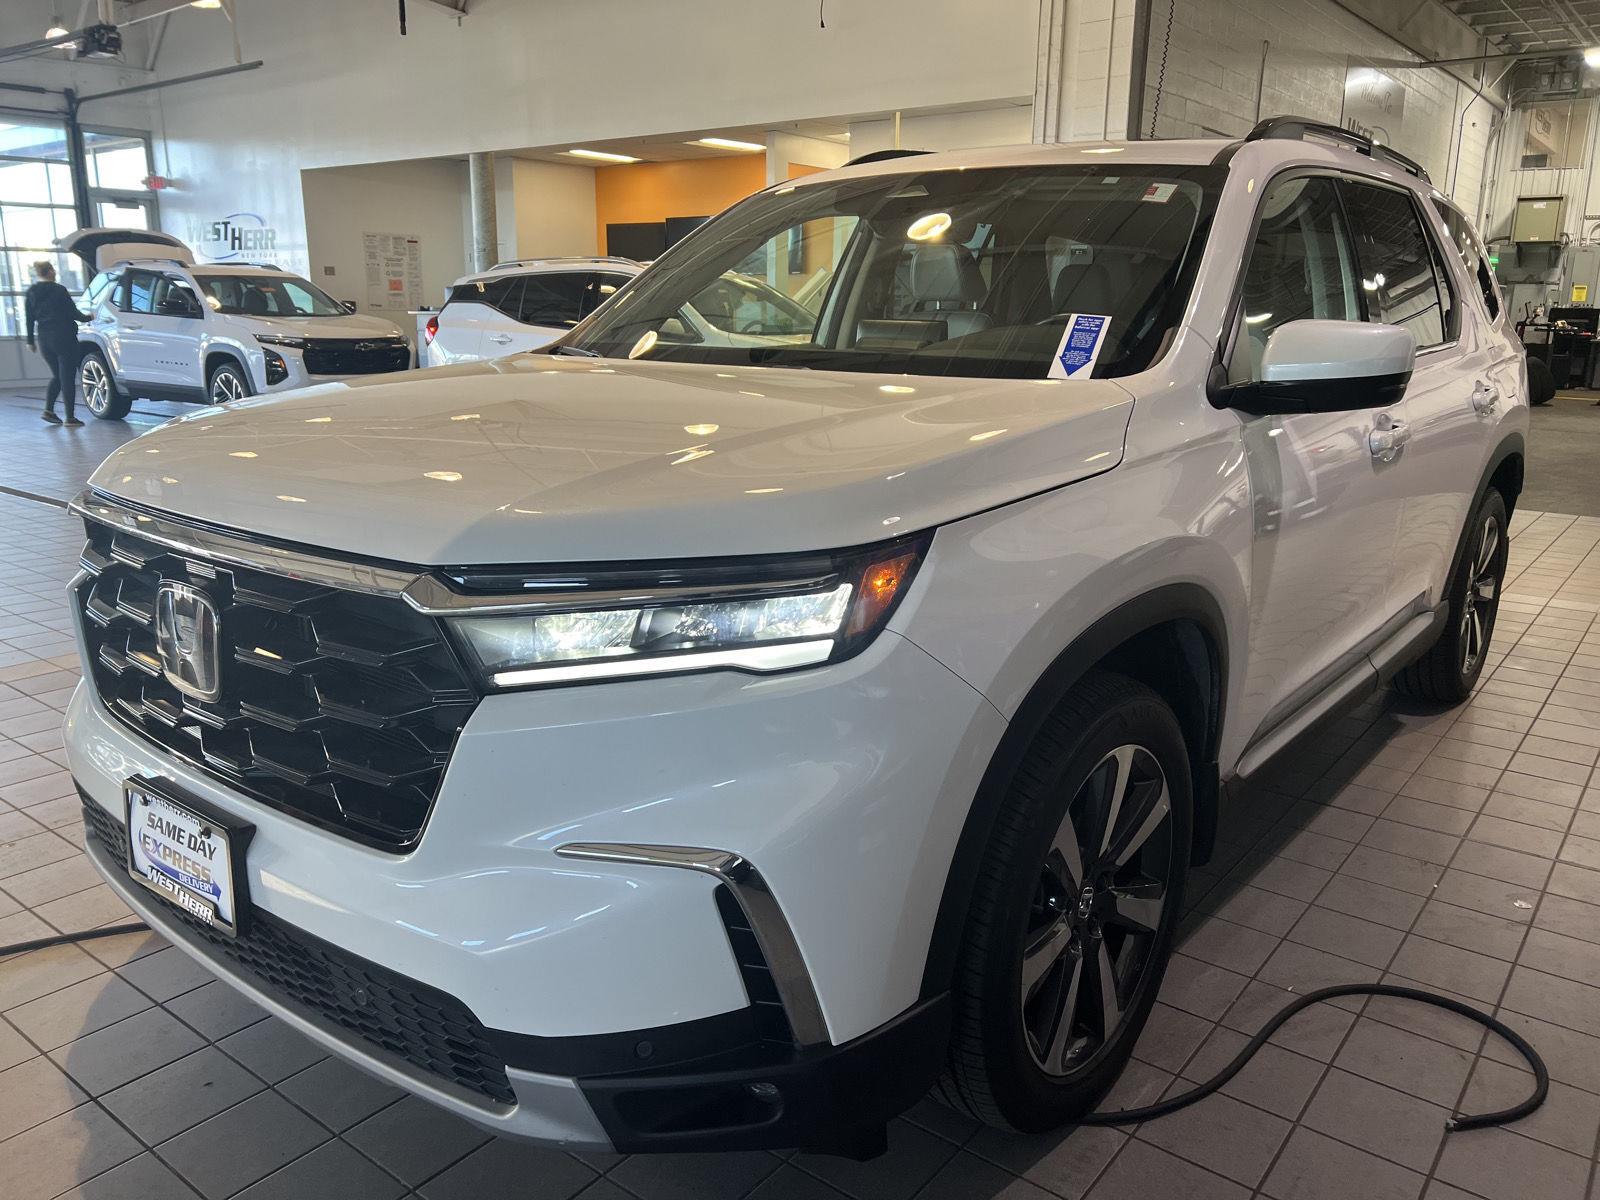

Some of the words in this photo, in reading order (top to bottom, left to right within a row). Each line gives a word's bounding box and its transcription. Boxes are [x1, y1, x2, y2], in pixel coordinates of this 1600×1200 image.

[187, 220, 231, 242] WEST
[231, 227, 276, 250] HERR
[141, 833, 213, 884] EXPRESS
[147, 811, 186, 846] SAME
[187, 832, 217, 861] DAY
[147, 866, 181, 896] WEST
[178, 888, 214, 921] HERR
[178, 872, 214, 895] DELIVERY
